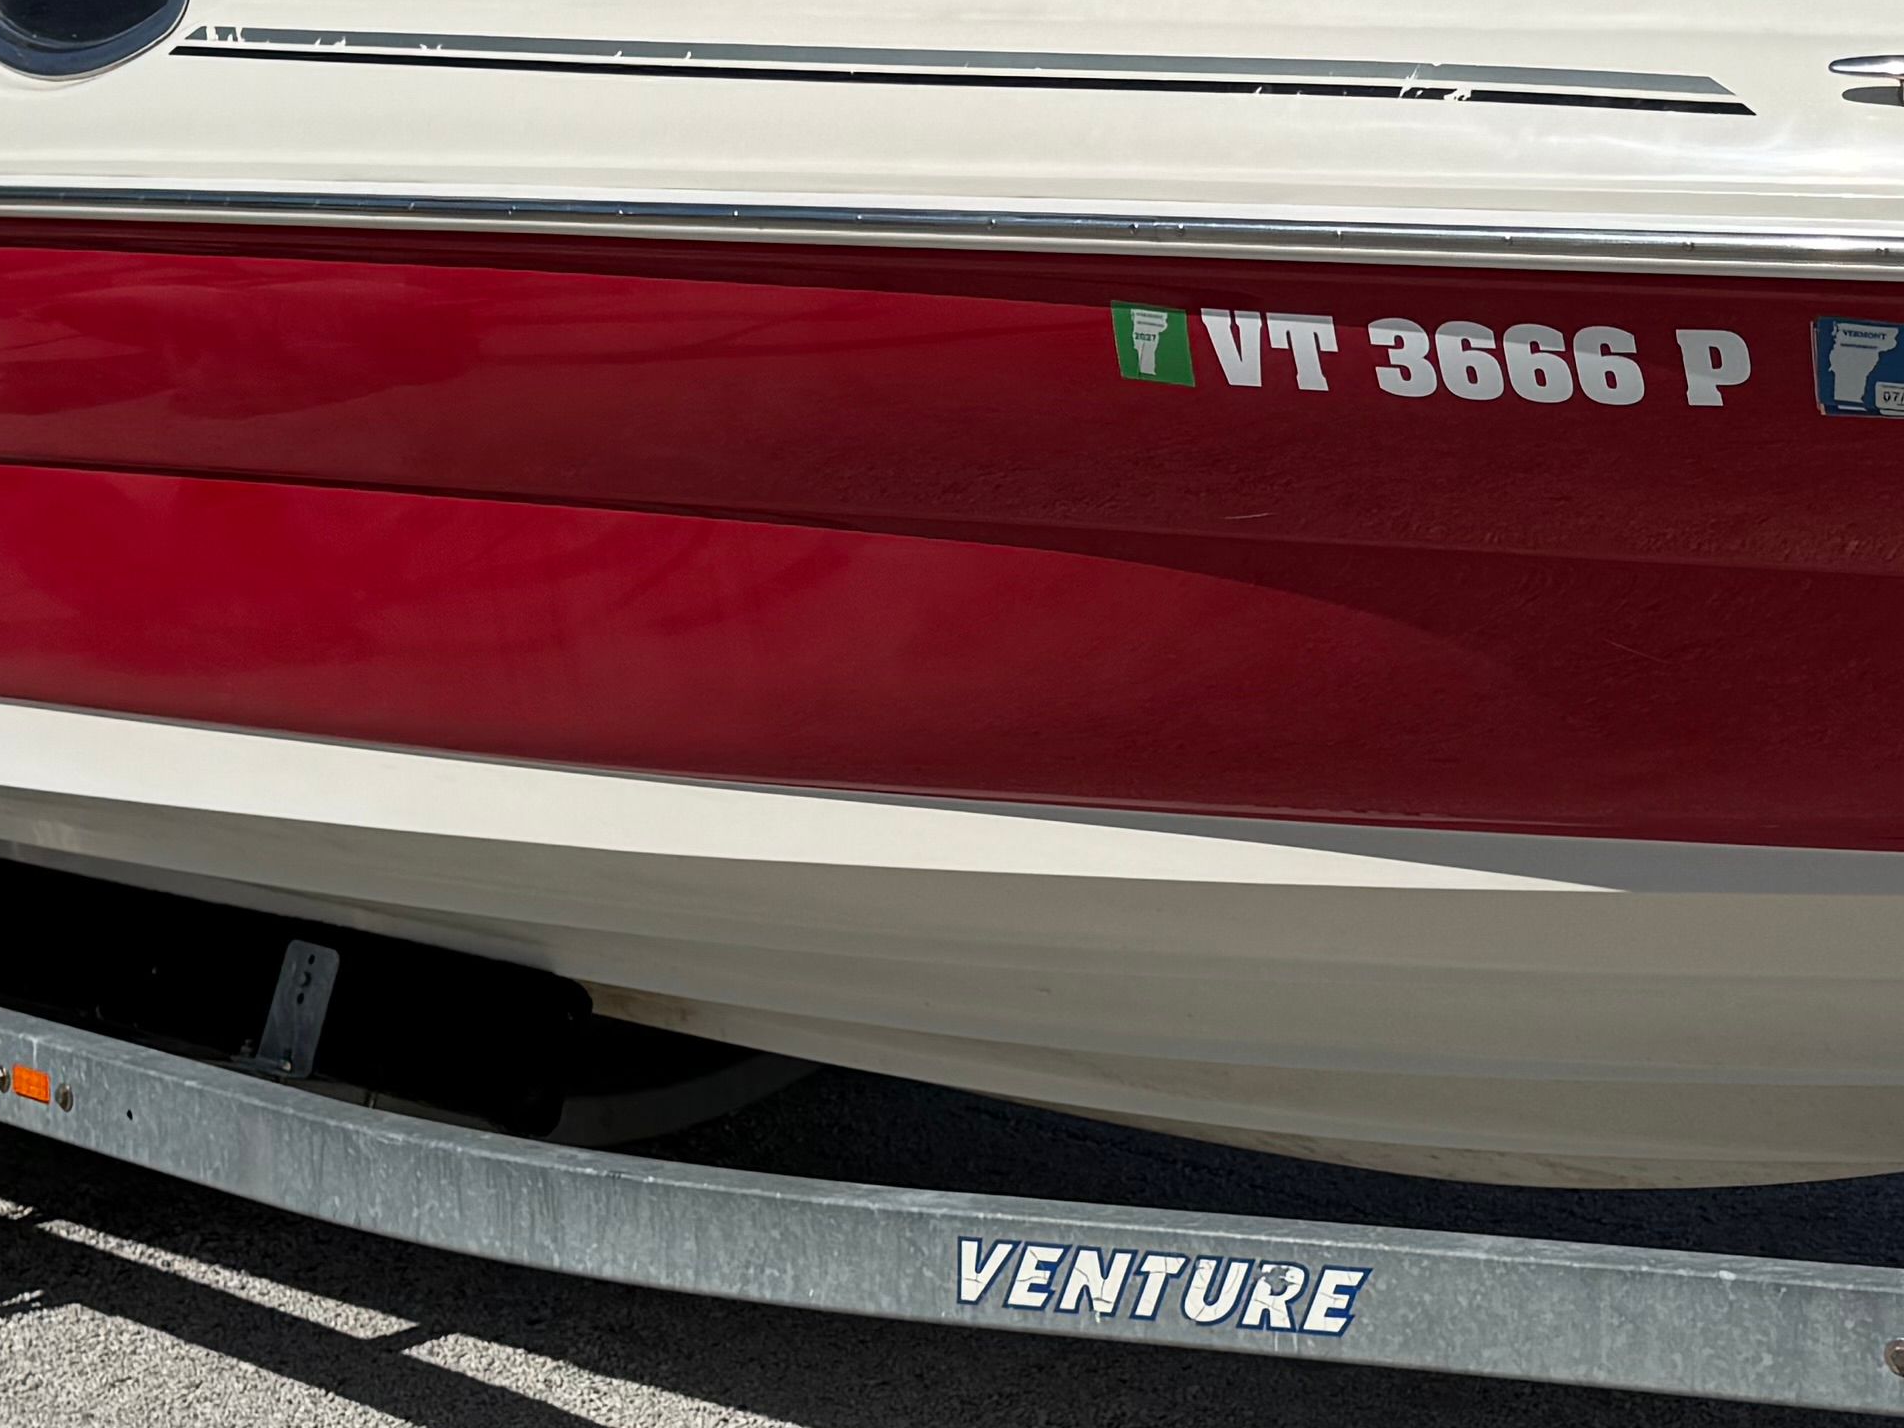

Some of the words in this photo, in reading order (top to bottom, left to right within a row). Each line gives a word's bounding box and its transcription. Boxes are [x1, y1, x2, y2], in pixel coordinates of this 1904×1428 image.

[1201, 307, 1339, 391] VT
[1368, 317, 1645, 405] 3666
[1676, 328, 1752, 406] P
[956, 1236, 1373, 1337] VENTURE
